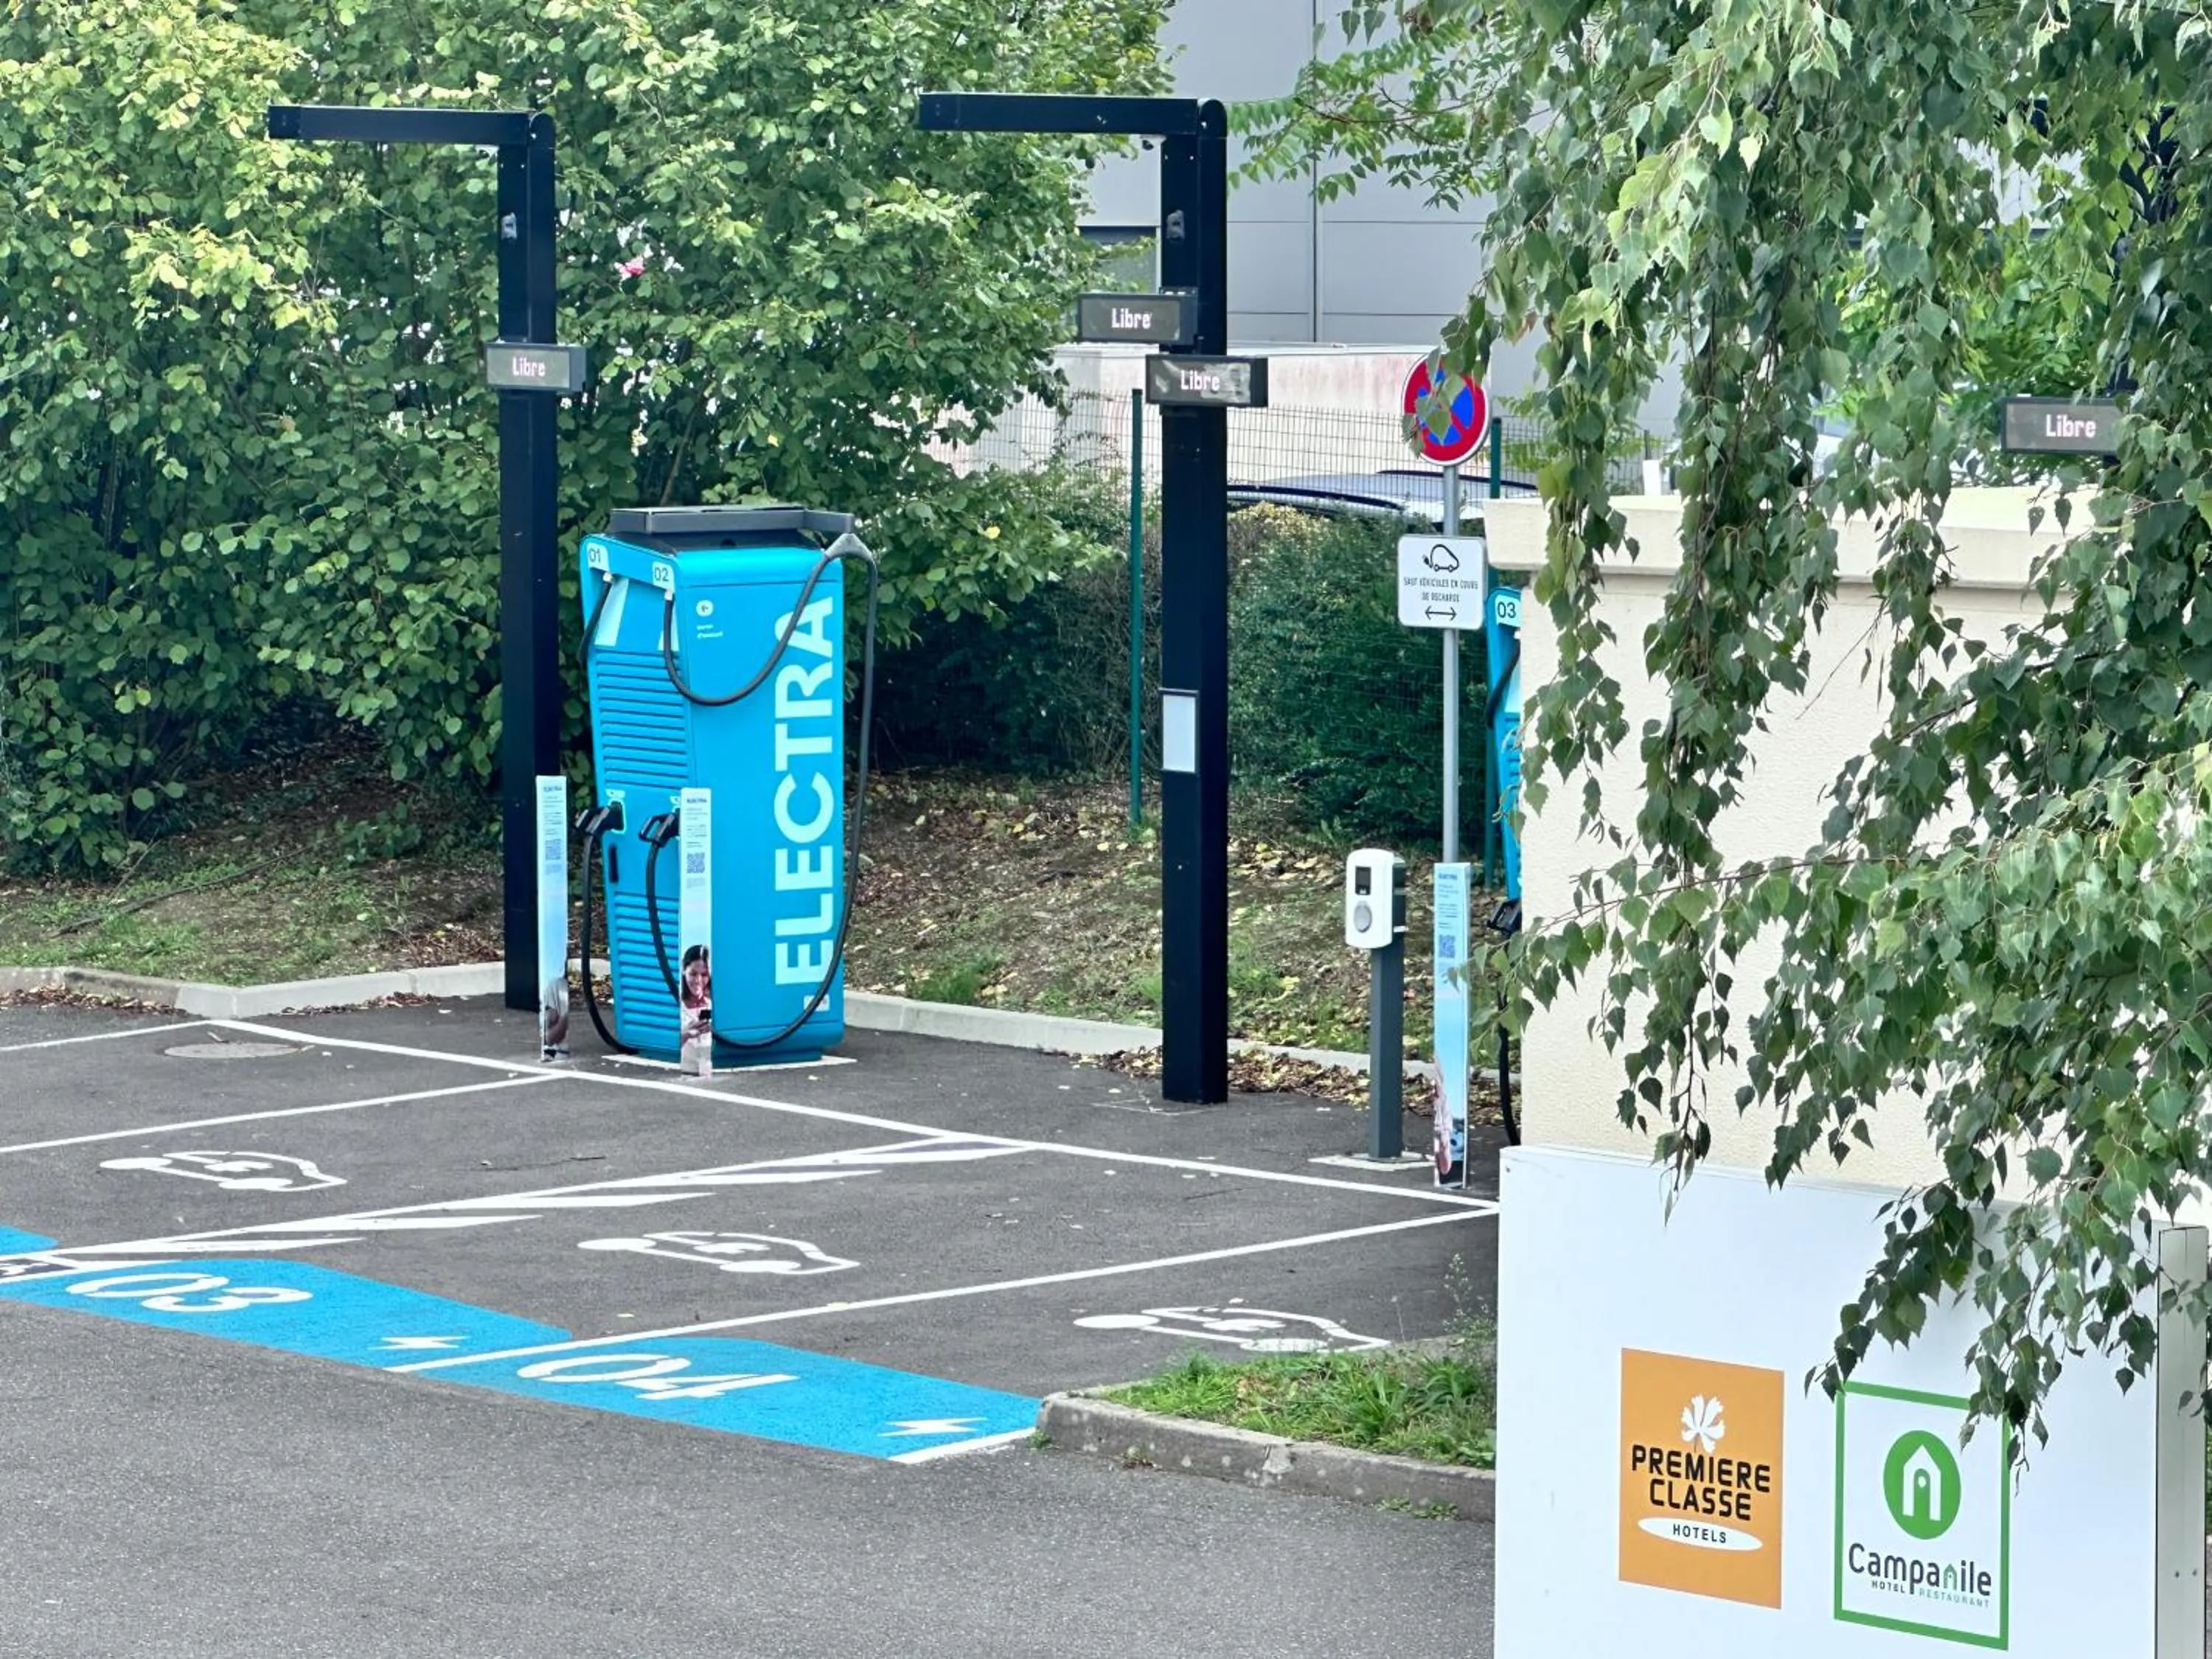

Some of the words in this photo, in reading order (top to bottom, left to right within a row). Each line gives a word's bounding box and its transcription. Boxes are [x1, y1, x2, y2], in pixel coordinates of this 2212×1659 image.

[1111, 307, 1152, 330] Libre
[512, 356, 546, 377] Libre
[1180, 369, 1220, 391] Libre
[2045, 413, 2097, 438] Libre
[588, 547, 601, 563] 01
[654, 566, 669, 582] 02
[1498, 601, 1517, 619] 03
[774, 596, 835, 984] ELECTRA
[66, 1273, 313, 1312] 03
[517, 1353, 800, 1400] 04
[1631, 1444, 1770, 1493] PREMIERE
[1649, 1478, 1752, 1521] CLASSE
[1672, 1523, 1727, 1544] HOTELS
[1848, 1542, 1992, 1596] Campanile
[1871, 1580, 1906, 1593] HOTEL
[1919, 1587, 1990, 1608] RESTAURANT
